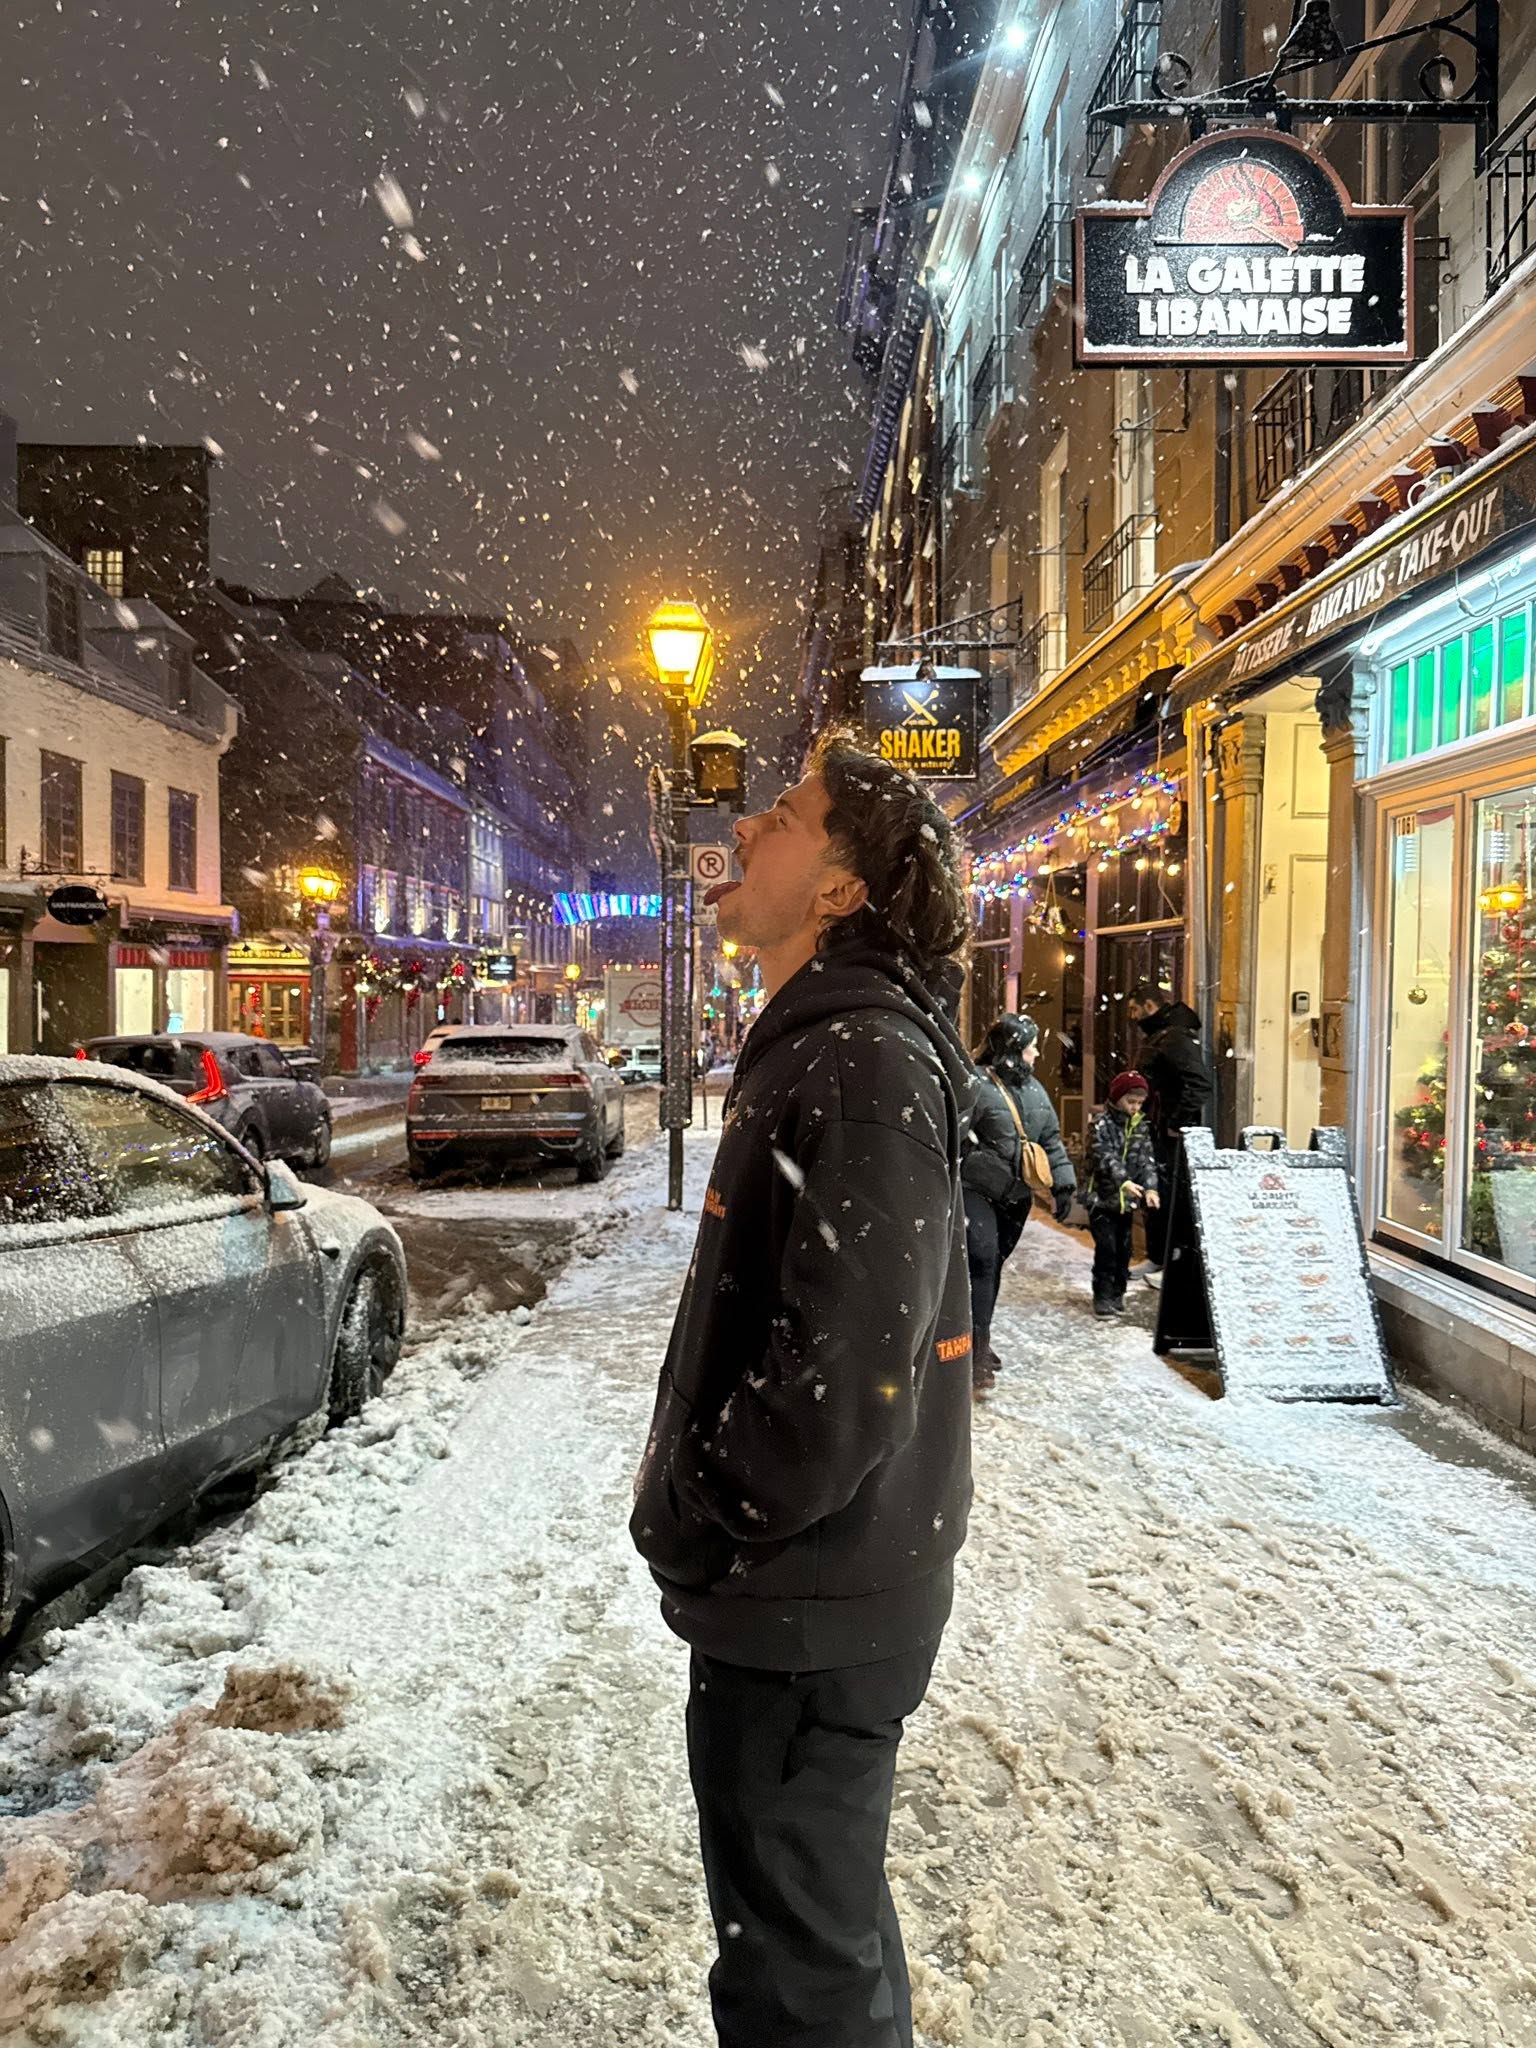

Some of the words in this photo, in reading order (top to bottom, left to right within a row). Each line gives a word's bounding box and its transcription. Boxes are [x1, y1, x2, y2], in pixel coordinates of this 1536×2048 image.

[1124, 255, 1175, 294] LA
[1187, 254, 1365, 294] GALETTE
[1137, 297, 1353, 336] LIBANAISE
[1305, 561, 1387, 638] BAKLAVAS
[1397, 488, 1499, 586] TAKE-OUT
[880, 729, 960, 759] SHAKER
